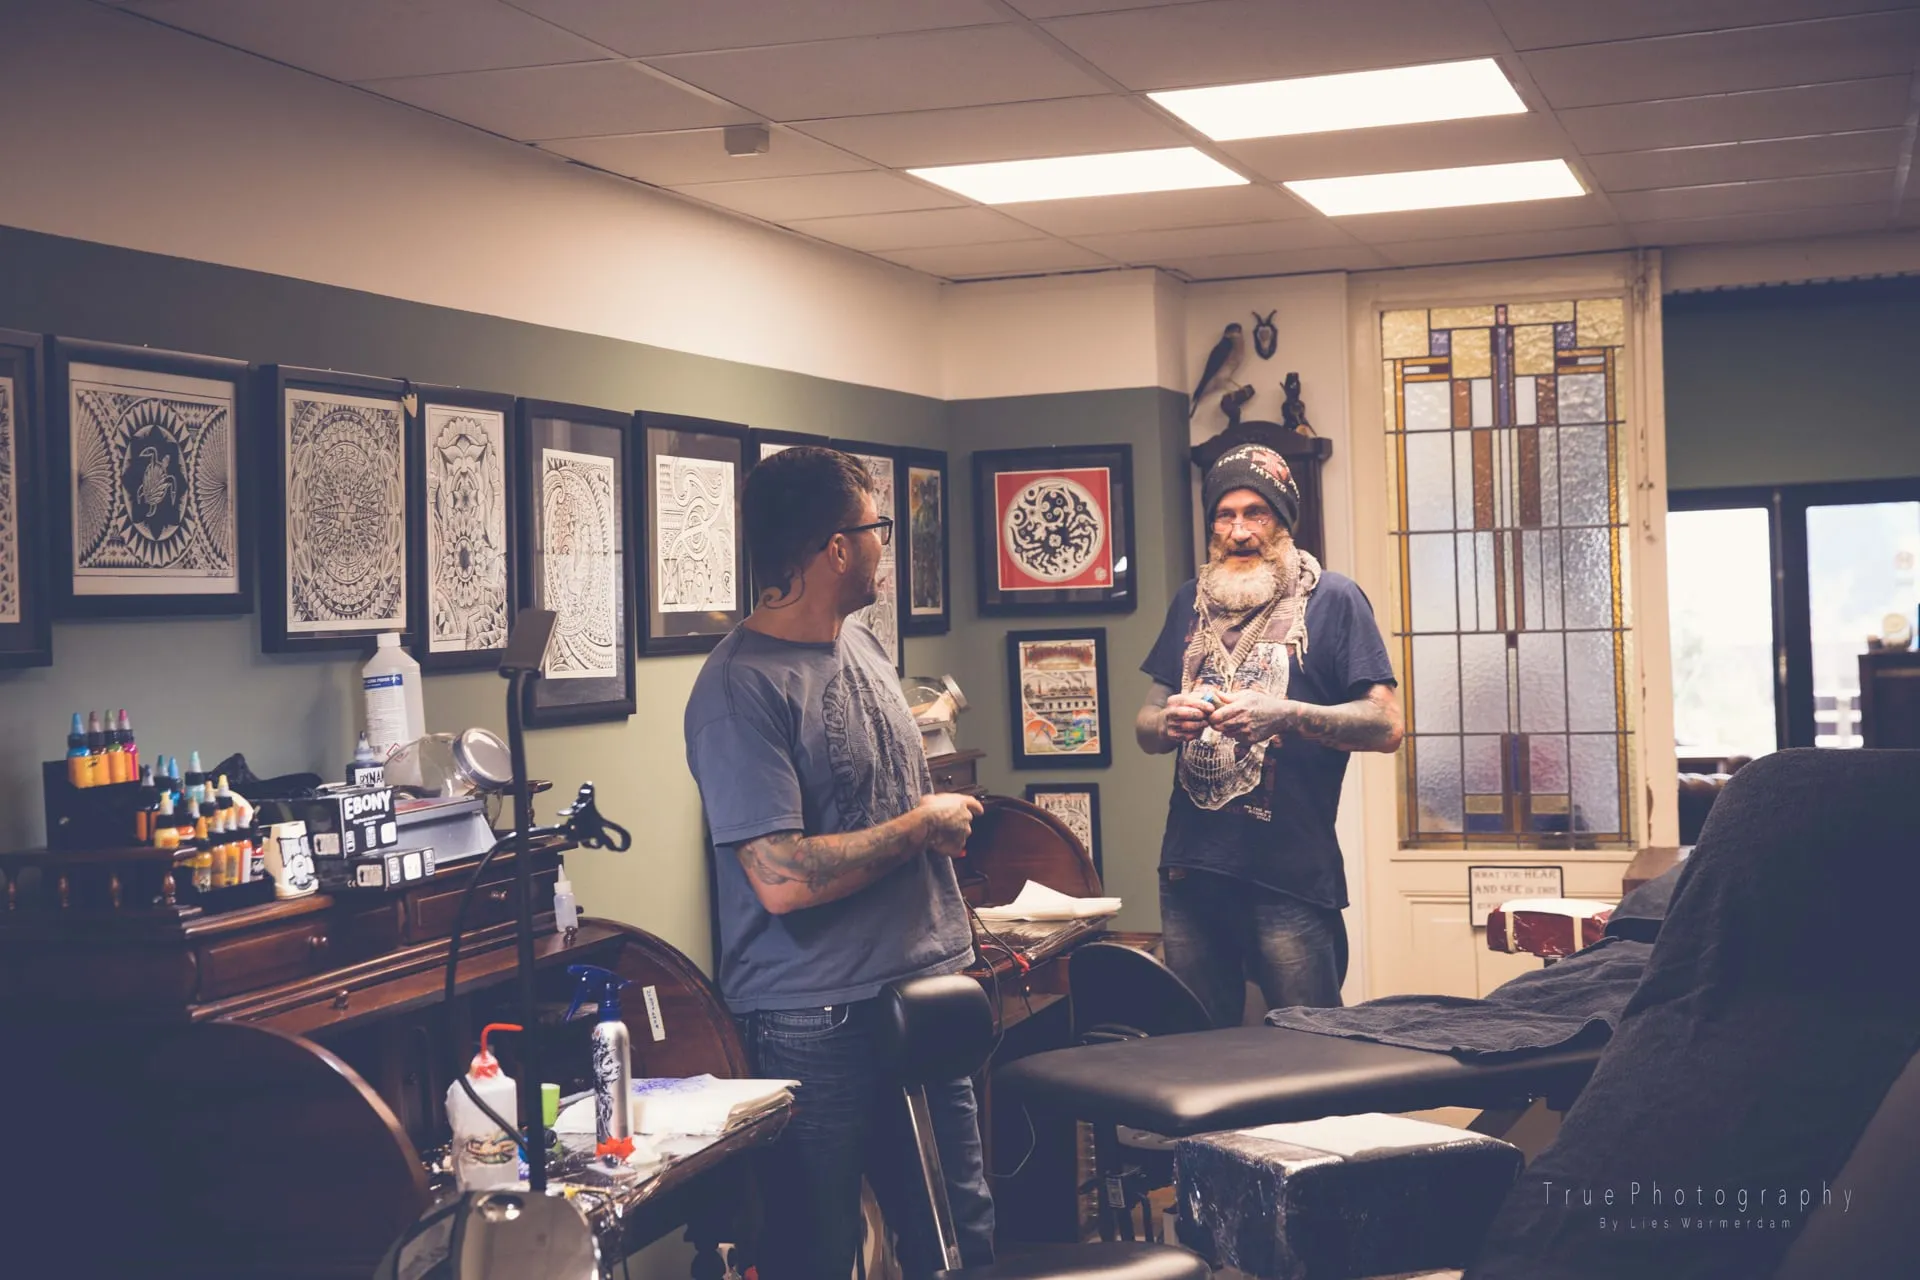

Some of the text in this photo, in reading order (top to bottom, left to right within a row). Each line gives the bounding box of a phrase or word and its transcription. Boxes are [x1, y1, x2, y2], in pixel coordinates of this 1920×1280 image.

[344, 789, 391, 820] EBONY
[1473, 871, 1500, 880] WHAT
[1524, 870, 1557, 879] HEAR
[1474, 884, 1498, 894] AND
[1500, 884, 1523, 894] SEE
